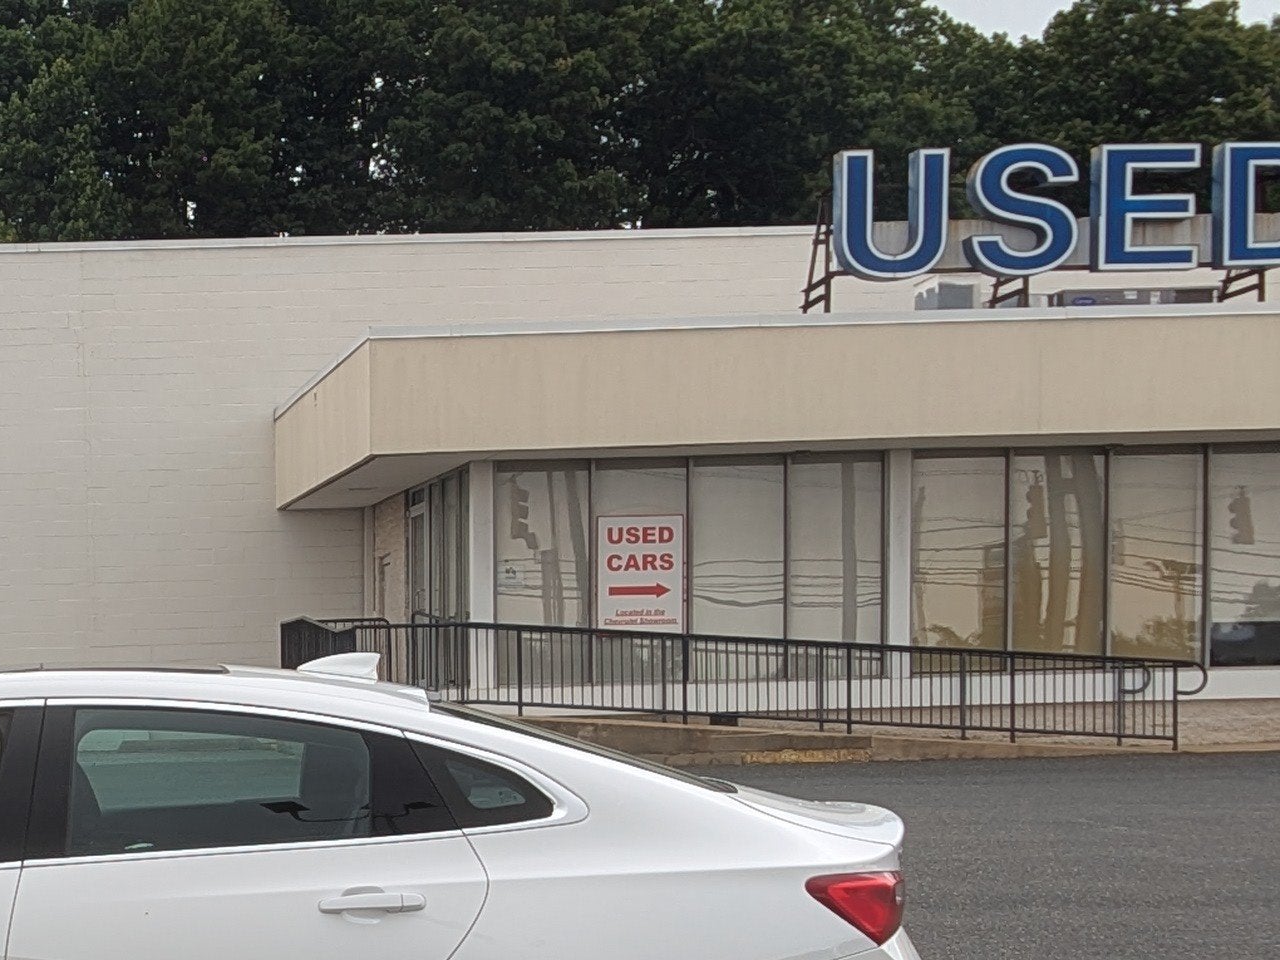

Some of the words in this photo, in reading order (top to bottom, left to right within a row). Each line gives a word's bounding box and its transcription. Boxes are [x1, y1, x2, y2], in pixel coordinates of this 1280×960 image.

[606, 526, 675, 545] USED
[606, 552, 675, 572] CARS
[615, 608, 644, 617] Located
